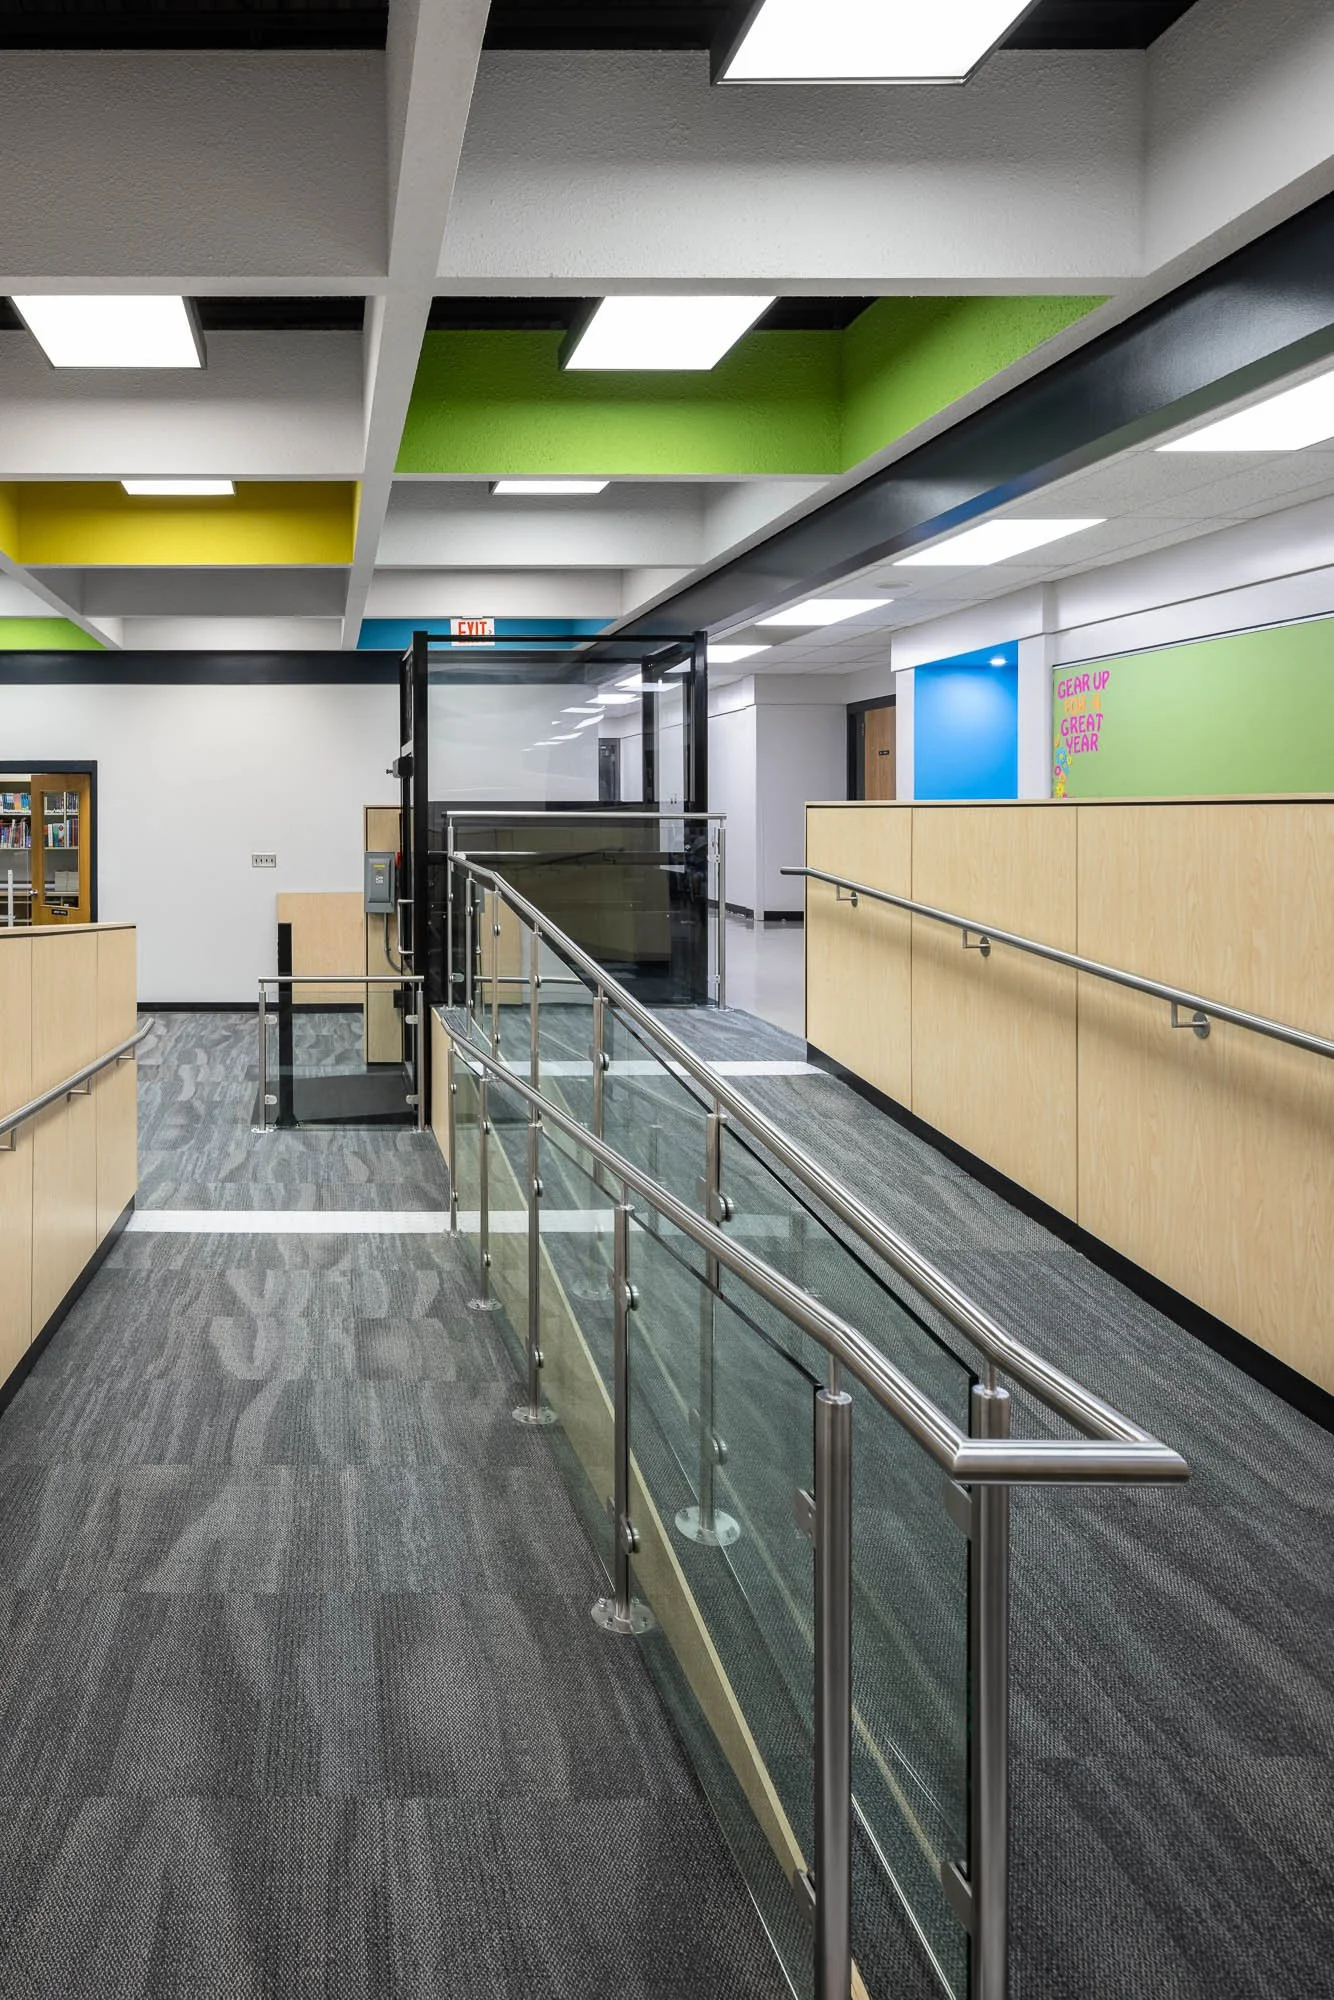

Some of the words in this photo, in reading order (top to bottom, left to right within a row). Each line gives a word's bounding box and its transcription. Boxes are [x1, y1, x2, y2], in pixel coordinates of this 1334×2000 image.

[458, 622, 487, 637] EXIT
[1057, 673, 1090, 700] GEAR
[1093, 670, 1110, 691] UP
[1064, 695, 1087, 716] FOR
[1091, 694, 1101, 713] A
[1060, 713, 1103, 736] GREAT
[1065, 733, 1099, 754] YEAR
